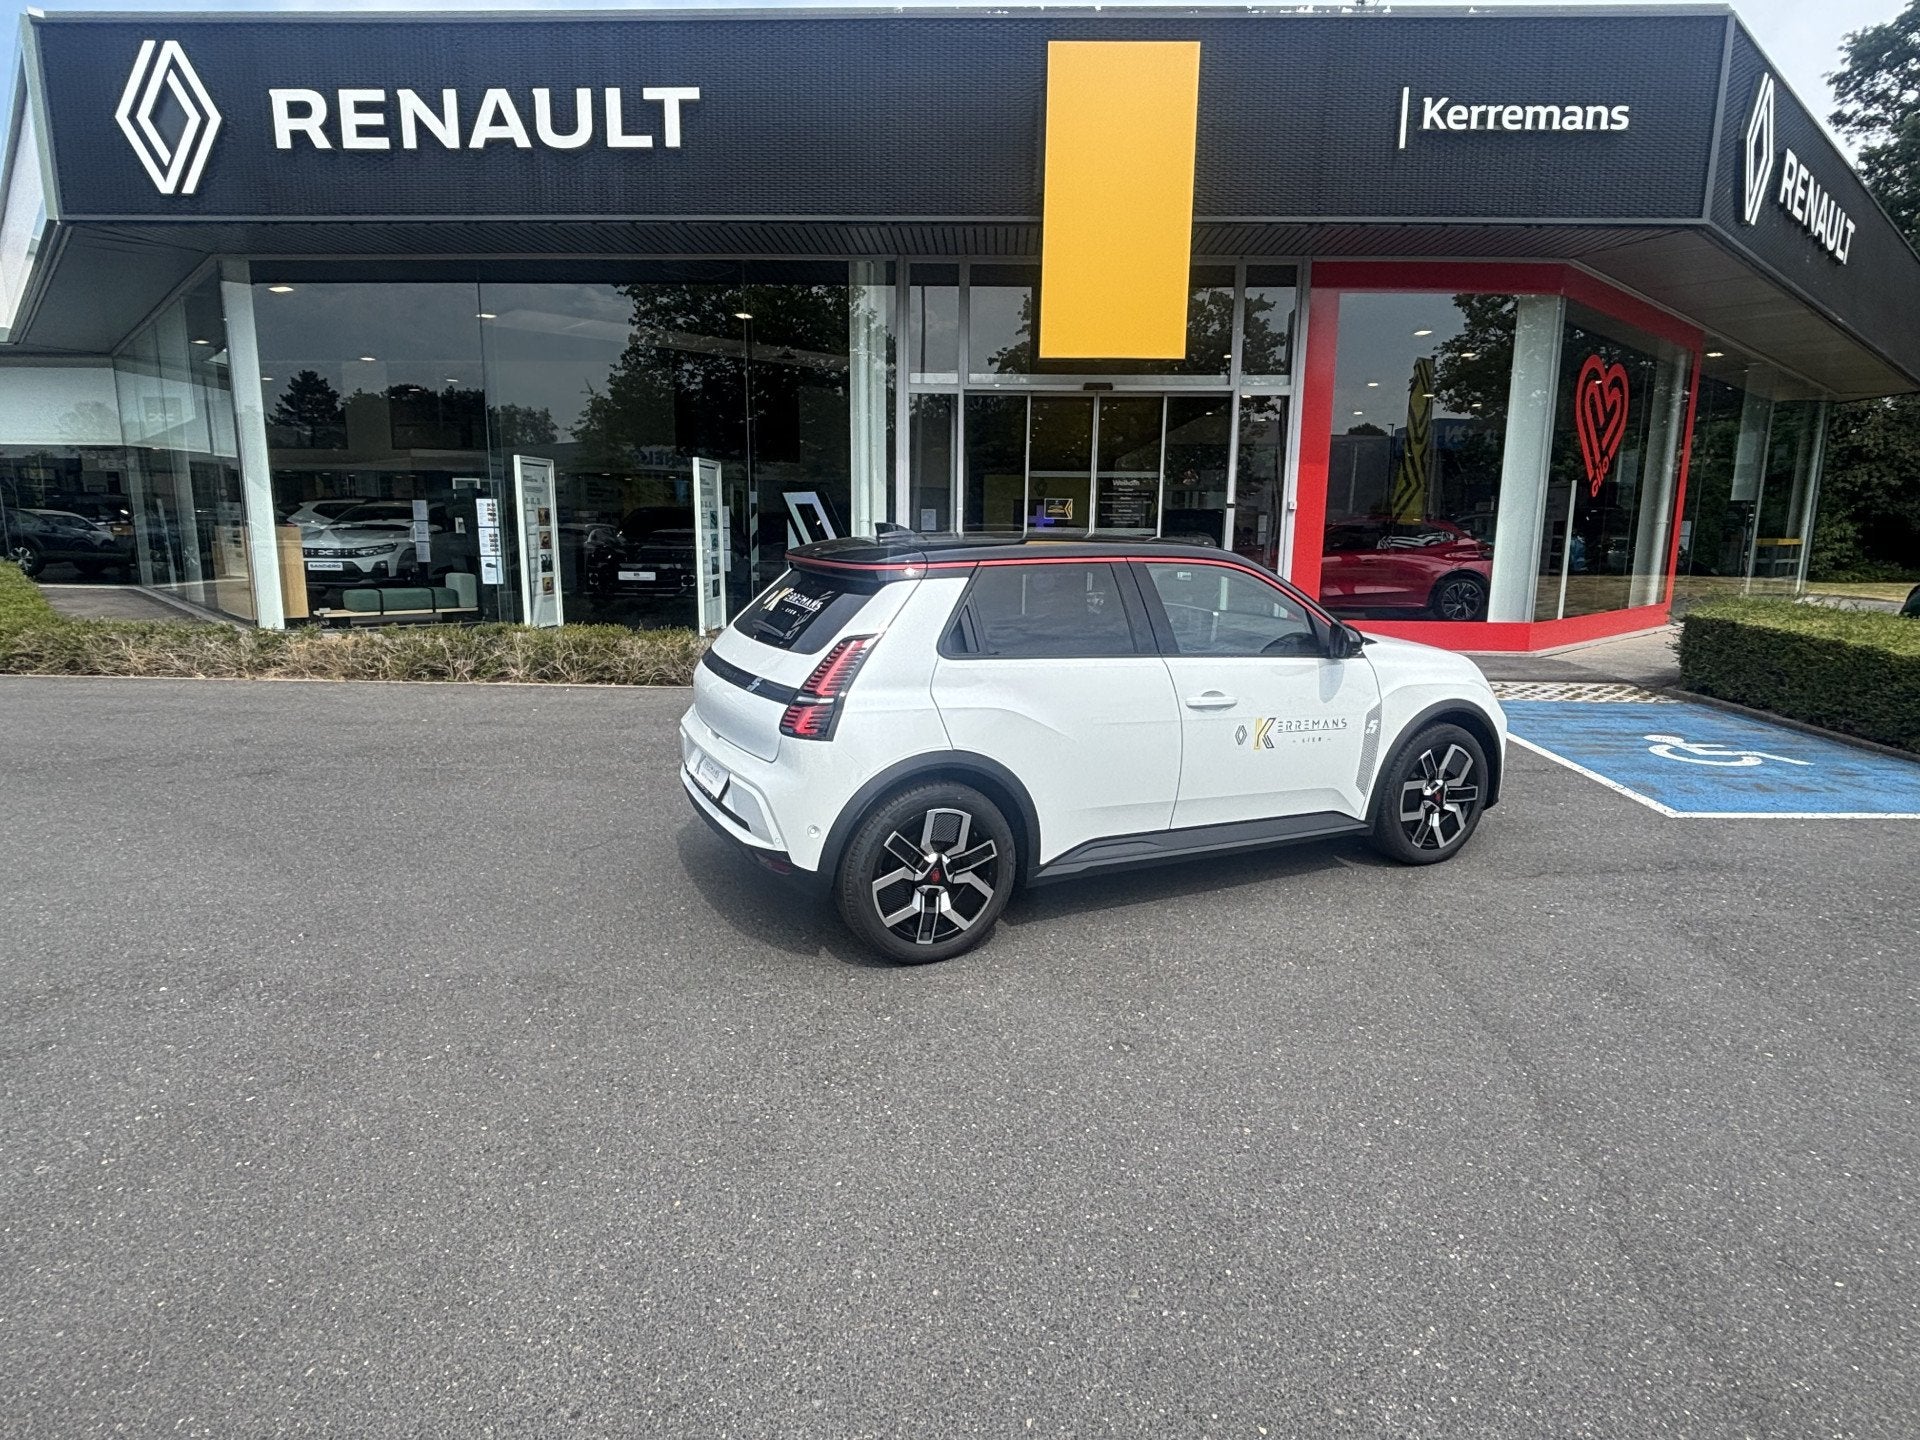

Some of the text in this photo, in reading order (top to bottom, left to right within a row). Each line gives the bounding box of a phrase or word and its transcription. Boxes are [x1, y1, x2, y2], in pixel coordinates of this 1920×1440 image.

[269, 87, 700, 150] RENAULT
[1422, 97, 1630, 131] Kerremans
[1779, 148, 1856, 265] RENAULT
[1591, 455, 1609, 498] clio
[1253, 717, 1348, 750] KERREMANS
